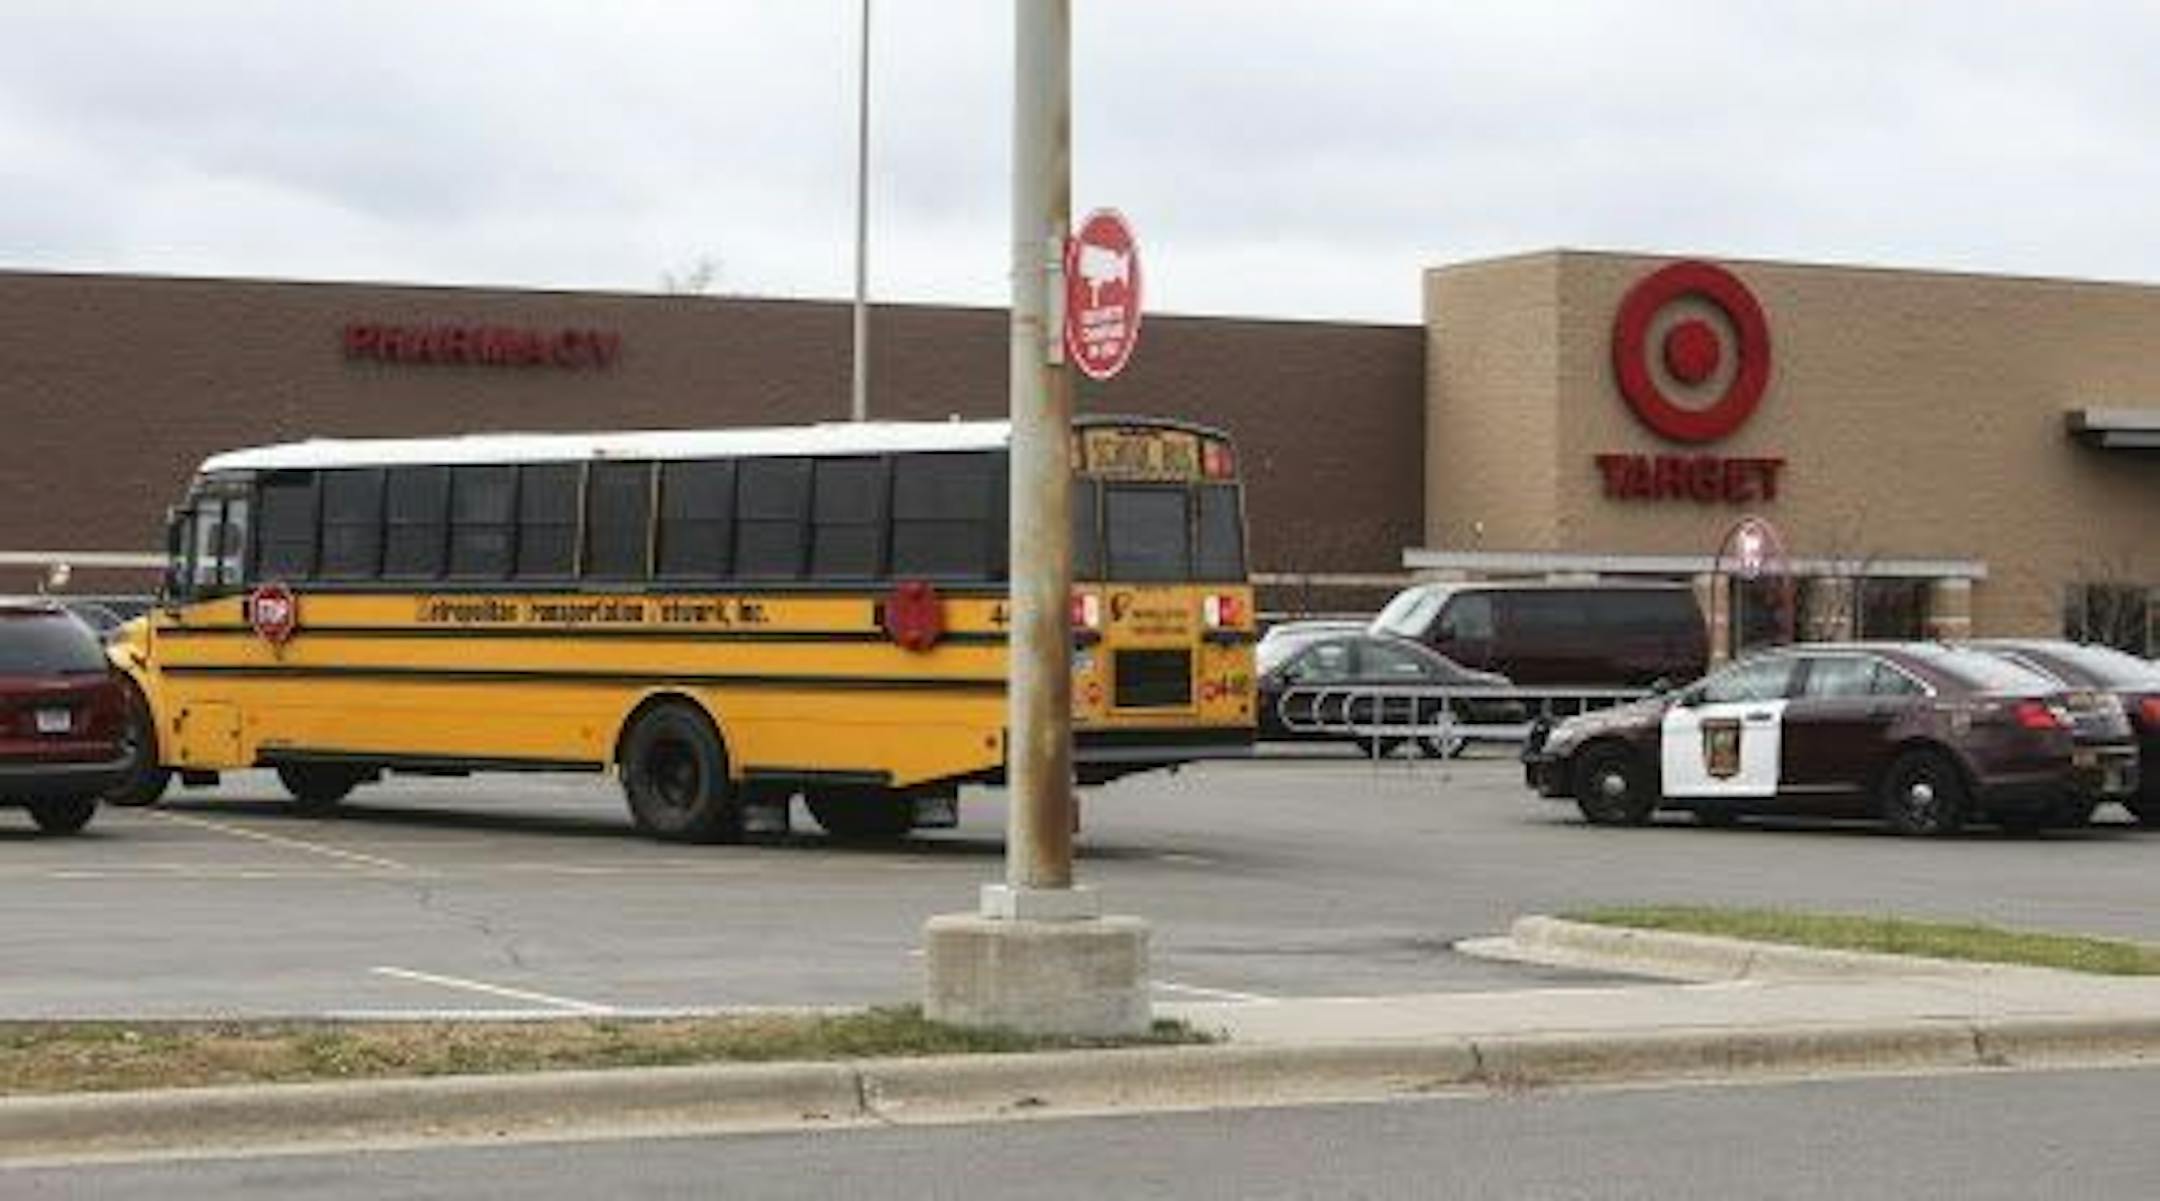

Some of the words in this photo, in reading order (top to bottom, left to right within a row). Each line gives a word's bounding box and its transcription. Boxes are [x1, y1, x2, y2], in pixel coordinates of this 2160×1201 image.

[343, 323, 622, 371] PHARMACY
[1595, 454, 1786, 505] TARGET
[258, 599, 290, 624] STOP
